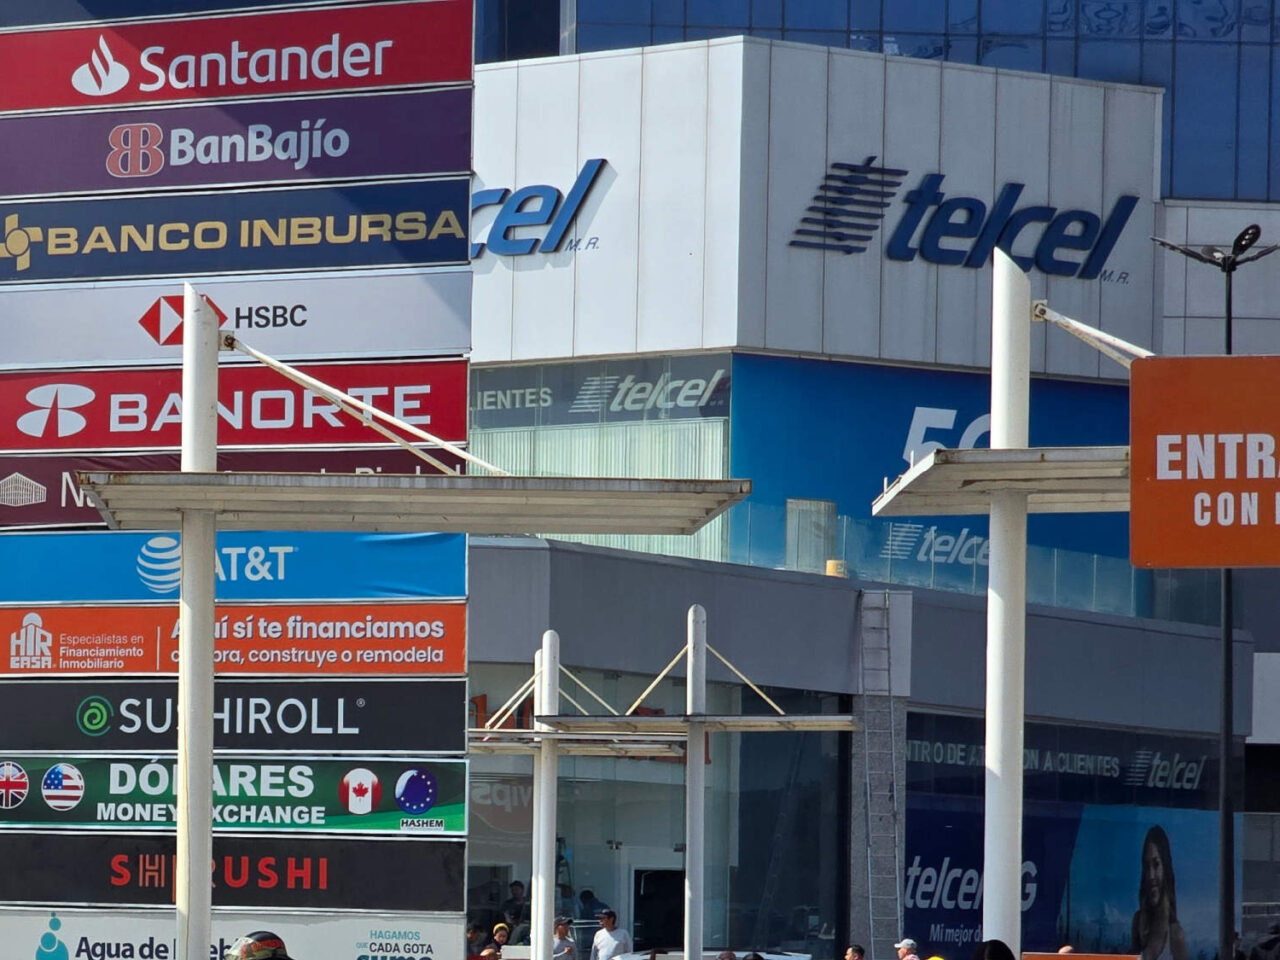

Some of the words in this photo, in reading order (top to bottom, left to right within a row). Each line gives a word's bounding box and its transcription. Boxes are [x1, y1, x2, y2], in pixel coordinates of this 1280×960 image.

[139, 33, 394, 92] Santander
[170, 118, 350, 170] BanBajío
[47, 221, 228, 256] BANCO
[240, 210, 466, 249] INBURSA
[886, 173, 1141, 280] telcel
[235, 304, 308, 328] HSBC
[477, 386, 553, 410] IENTES
[610, 369, 726, 412] telcel
[1156, 433, 1280, 480] ENTR
[1194, 492, 1259, 526] CON
[233, 615, 254, 638] sí
[258, 618, 282, 638] te
[286, 615, 444, 639] financiamos
[10, 624, 53, 656] HIR
[59, 633, 128, 646] Especialistas
[131, 635, 144, 644] en
[59, 646, 144, 657] Financiamiento
[59, 659, 125, 669] Inmobiliario
[248, 647, 337, 667] construye
[341, 650, 353, 663] o
[356, 646, 444, 663] remodela
[120, 697, 360, 735] SUHIROLL
[948, 743, 966, 766] DE
[1148, 751, 1207, 789] telcel
[212, 805, 326, 824] XCHANGE
[401, 819, 444, 827] HASHEM
[370, 930, 421, 941] HAGAMOS
[930, 924, 944, 941] Mi
[945, 926, 972, 946] mejor
[138, 936, 168, 960] de
[369, 942, 401, 953] CADA
[403, 943, 434, 954] GOTA
